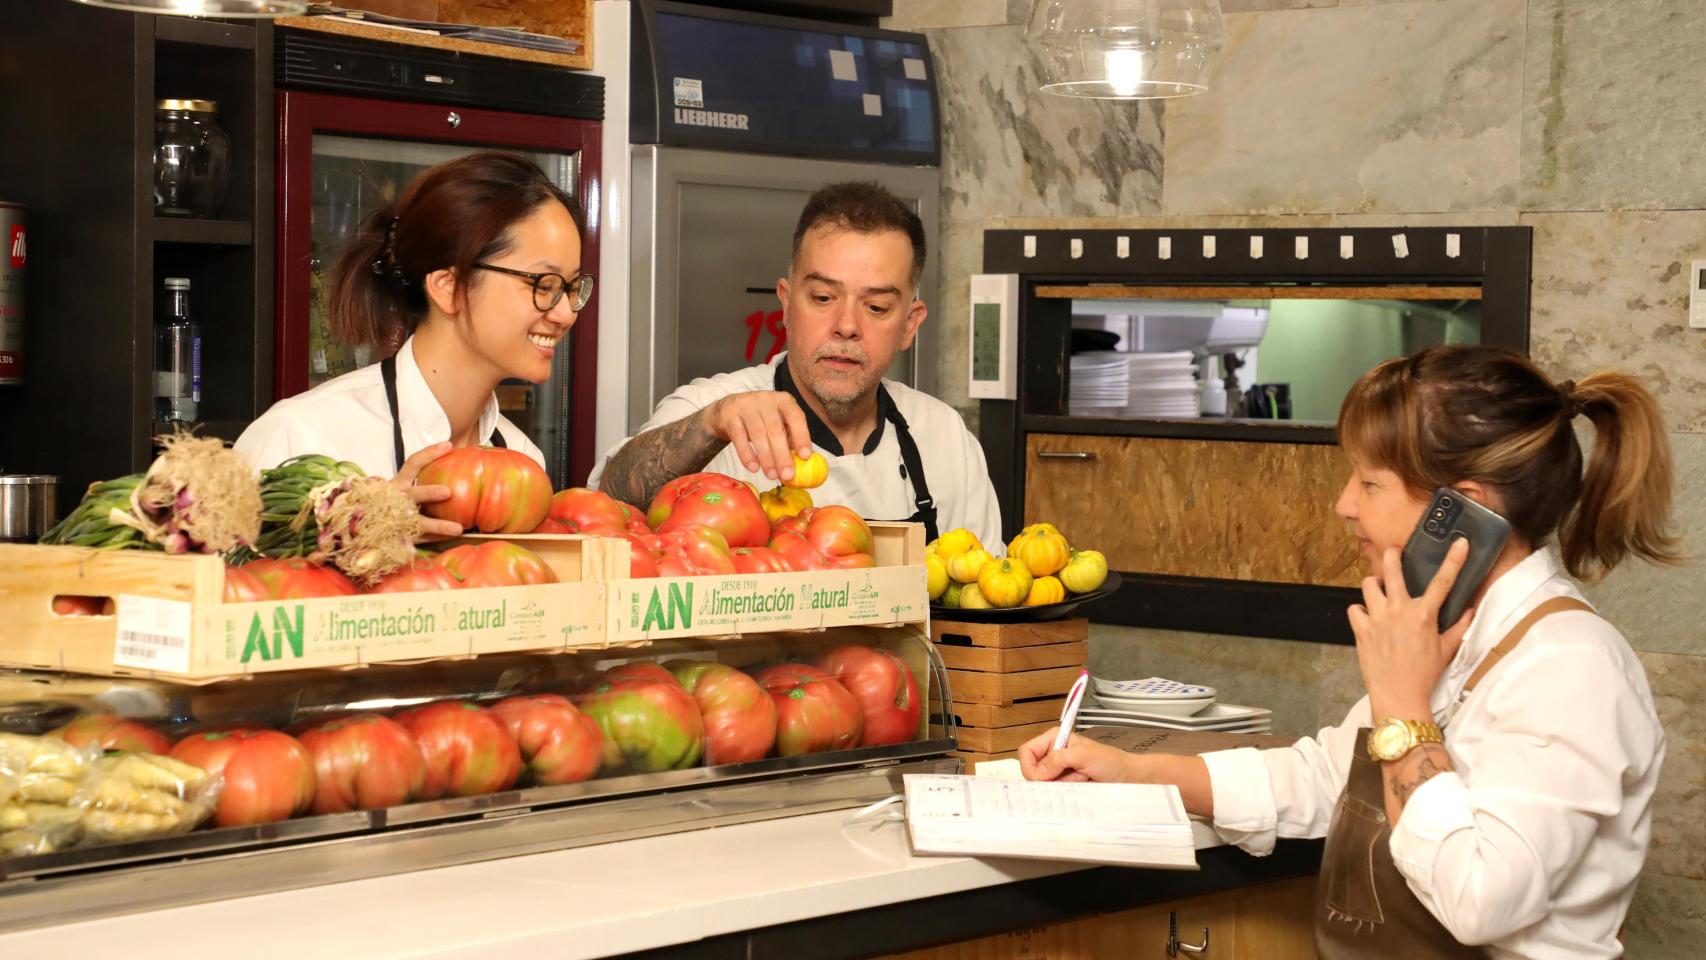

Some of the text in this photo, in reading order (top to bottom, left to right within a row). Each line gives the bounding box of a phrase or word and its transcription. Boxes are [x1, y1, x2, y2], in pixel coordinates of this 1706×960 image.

[674, 107, 749, 130] LIEBHERR
[699, 587, 795, 616] Alimentación
[799, 581, 850, 610] Natural
[721, 580, 742, 591] DESDE
[313, 606, 435, 642] Alimentación
[641, 582, 694, 631] AN
[240, 605, 304, 663] AN
